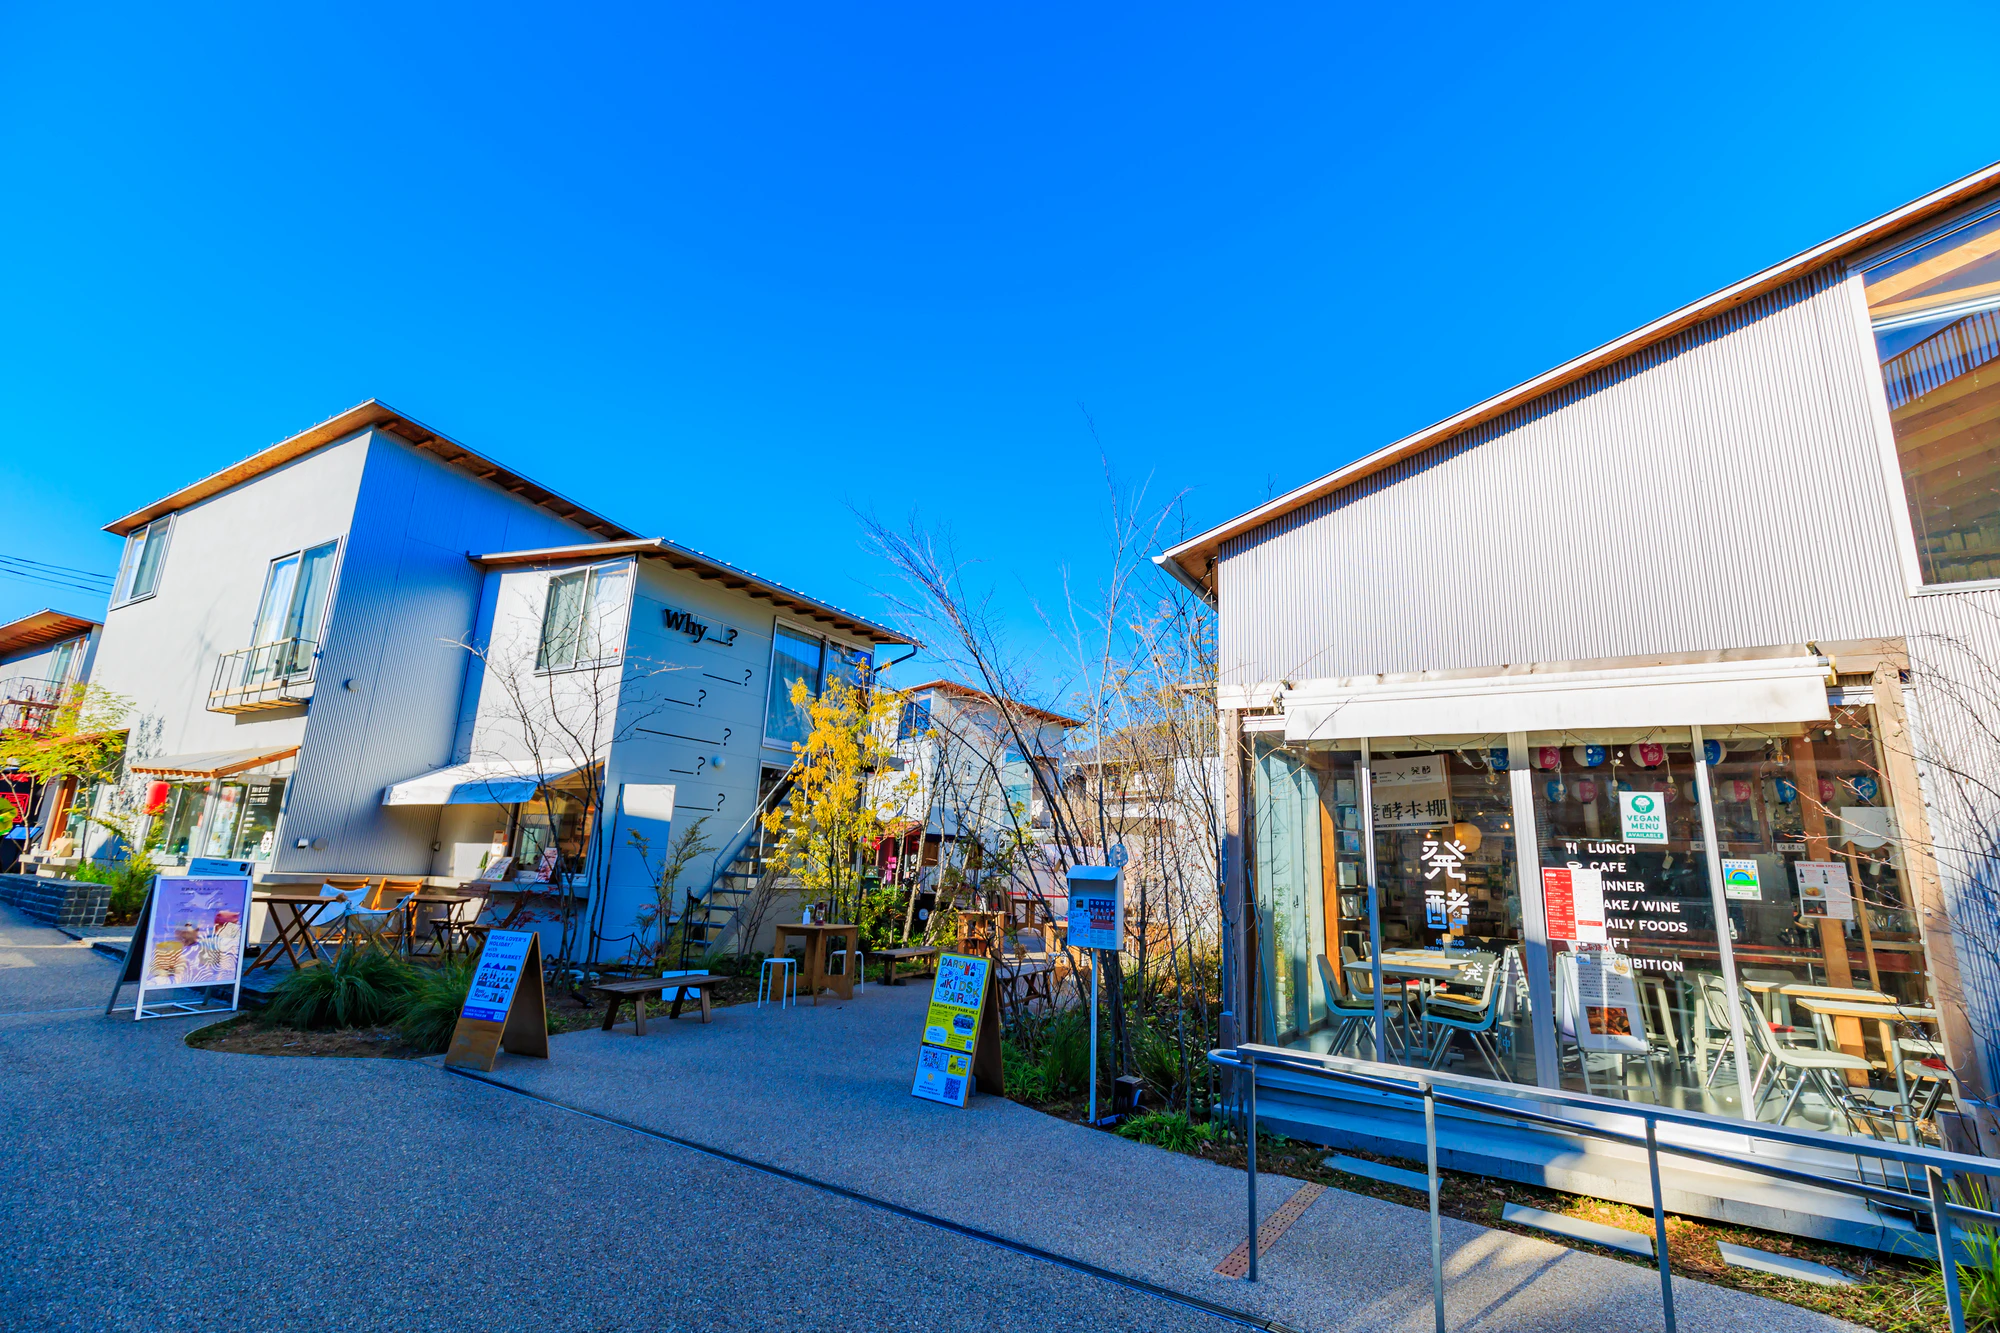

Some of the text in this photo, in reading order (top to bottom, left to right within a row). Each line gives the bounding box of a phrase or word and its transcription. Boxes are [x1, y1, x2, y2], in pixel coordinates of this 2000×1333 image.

[664, 609, 708, 643] Why
[1626, 814, 1661, 822] VEGAN
[1631, 822, 1659, 830] MENU
[1588, 843, 1636, 855] LUNCH
[1590, 861, 1627, 873] CAFE
[1421, 839, 1470, 930] 発酵
[1602, 880, 1645, 892] INNER
[1604, 899, 1630, 911] AKE
[1641, 900, 1680, 913] WINE
[1606, 918, 1688, 933] AILY FOODS
[505, 935, 527, 943] LOVER'S
[1608, 937, 1630, 949] IFT
[941, 957, 977, 972] DARUMA
